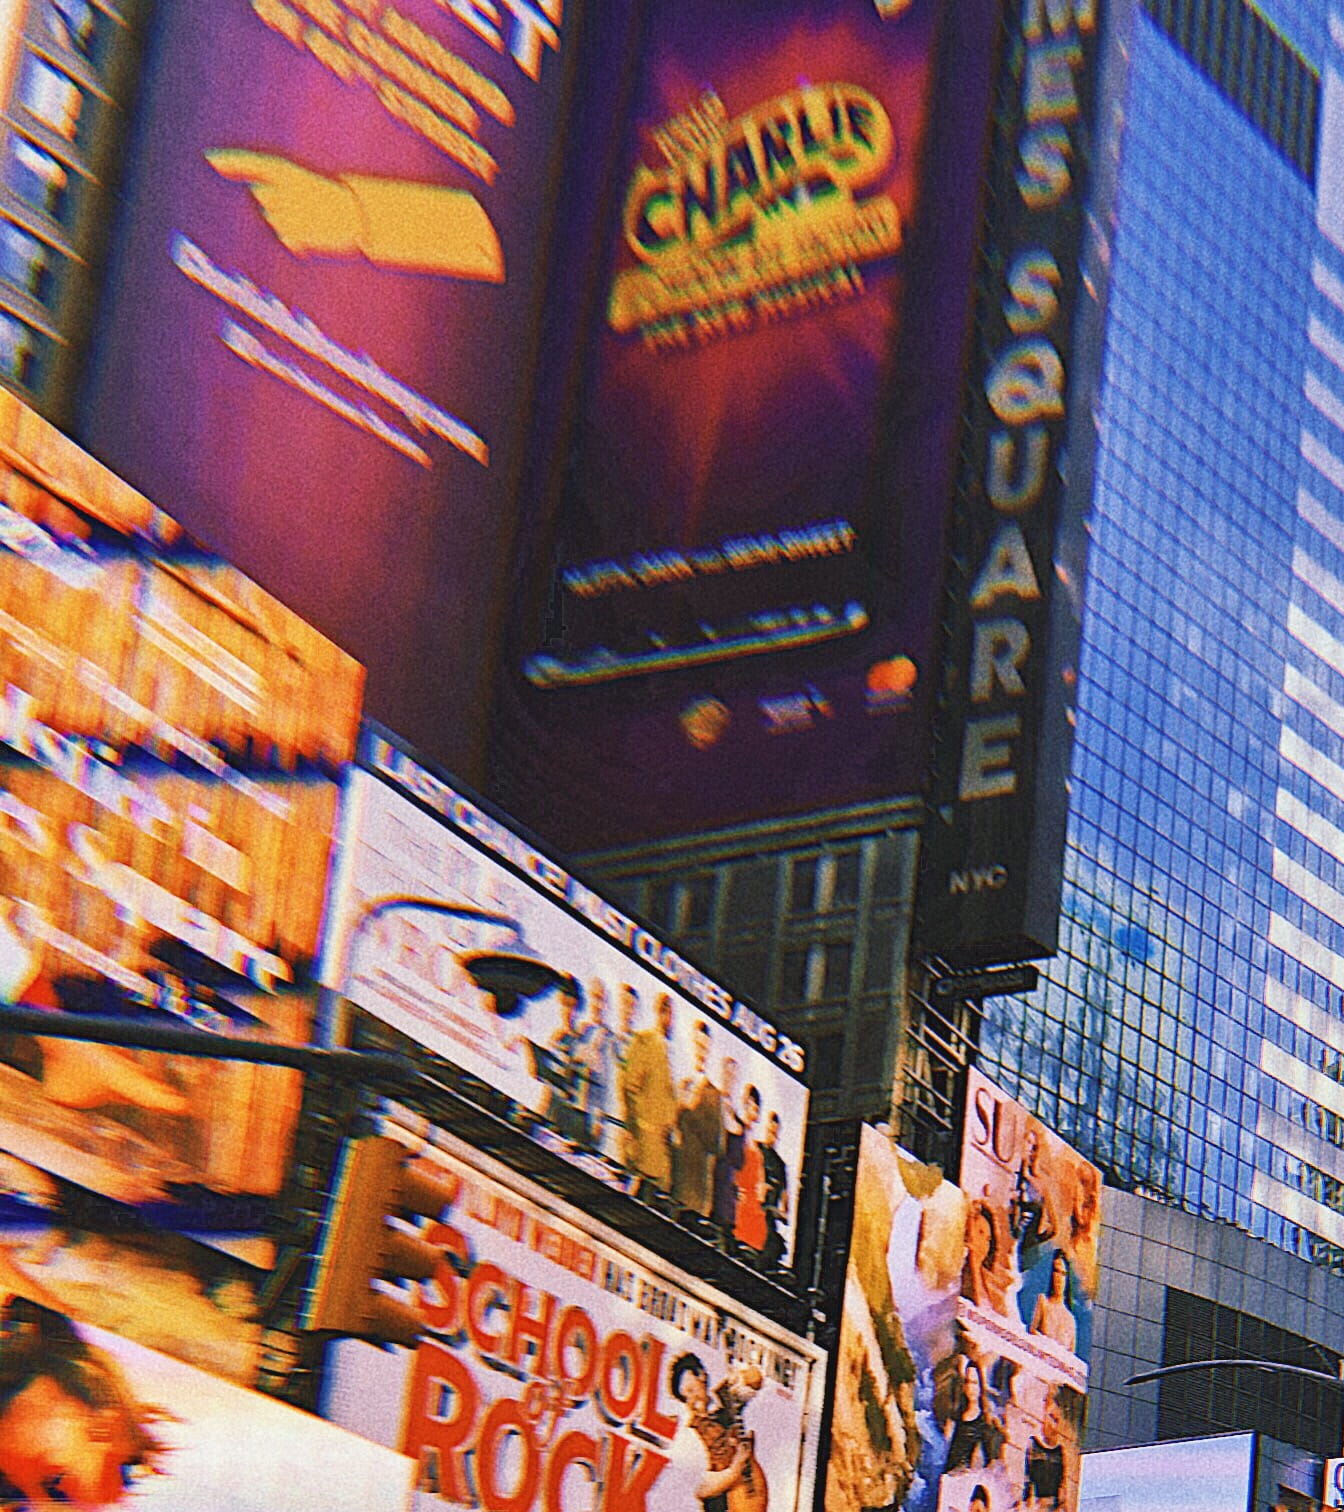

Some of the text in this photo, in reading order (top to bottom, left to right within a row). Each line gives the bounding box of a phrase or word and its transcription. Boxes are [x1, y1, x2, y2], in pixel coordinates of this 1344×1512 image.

[958, 248, 1066, 802] SQUARE
[732, 1001, 777, 1053] AUG
[414, 1222, 680, 1442] SCHOOL
